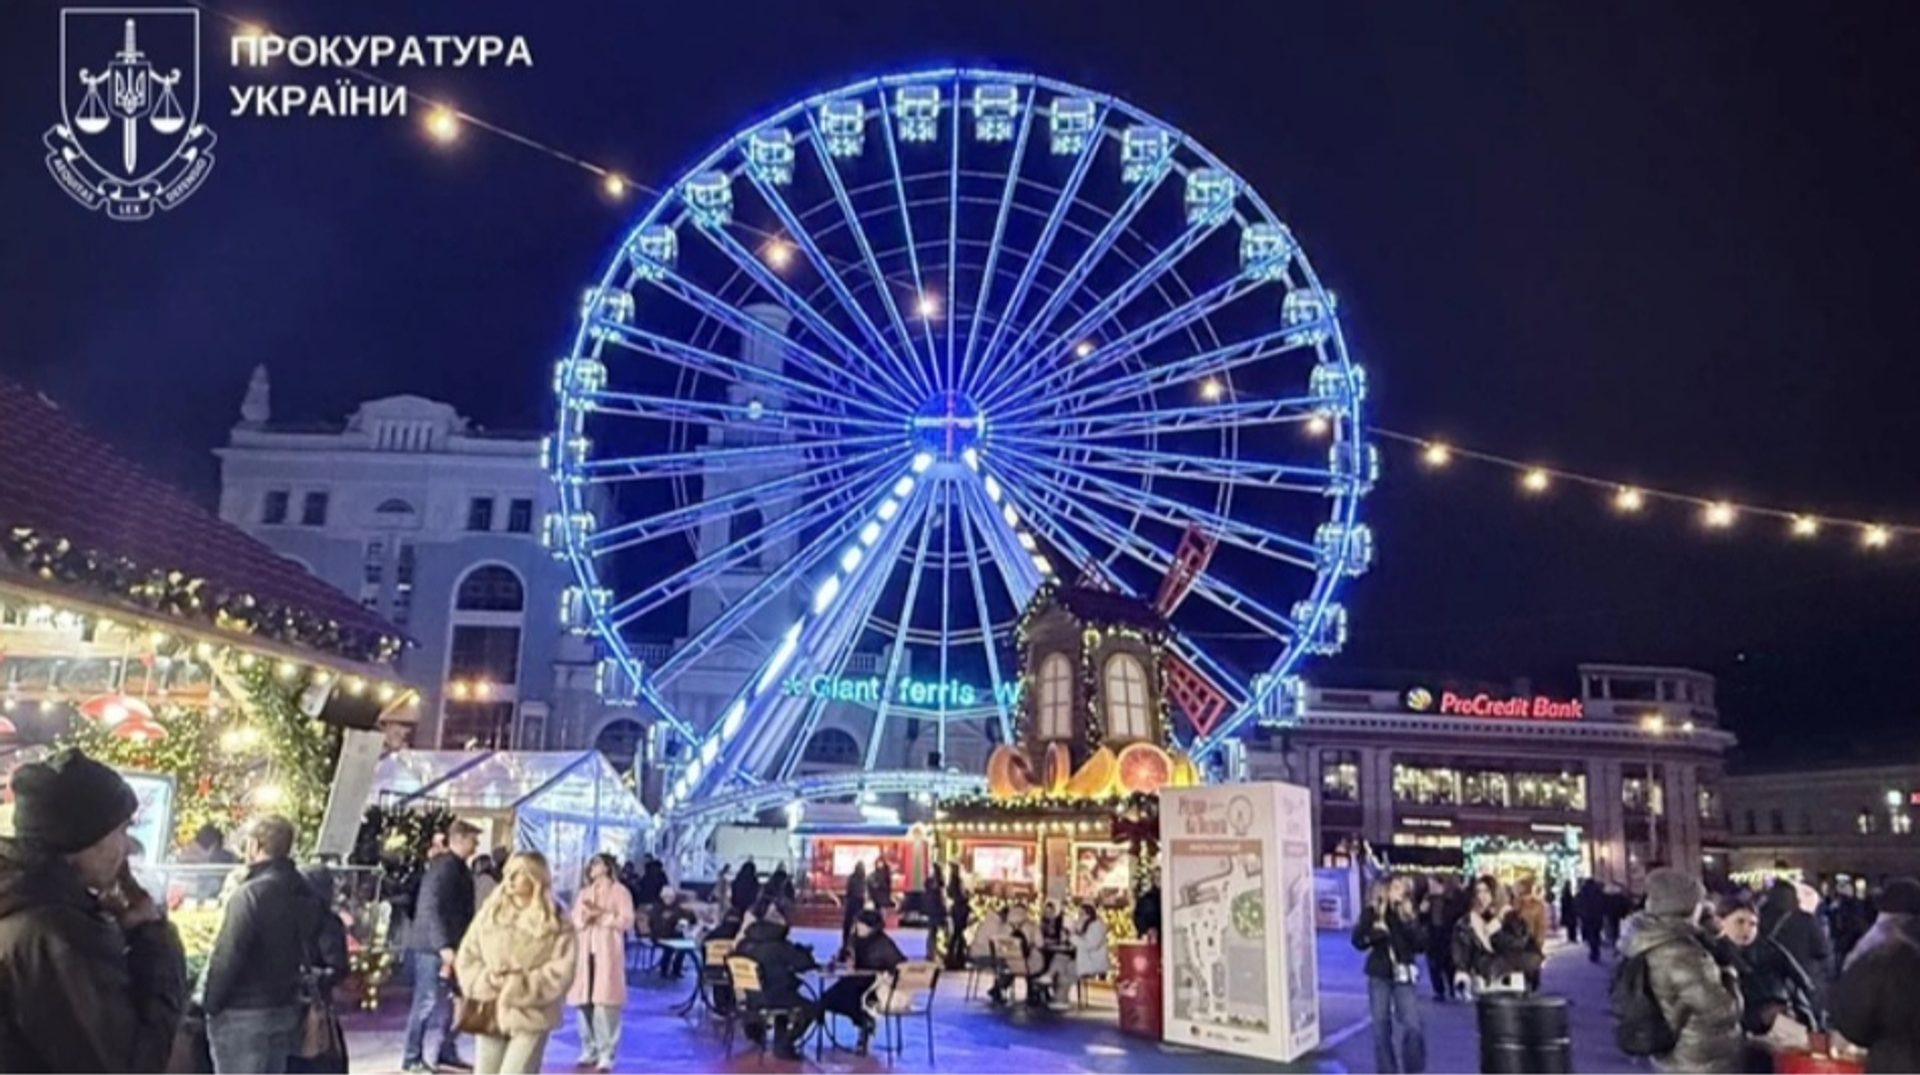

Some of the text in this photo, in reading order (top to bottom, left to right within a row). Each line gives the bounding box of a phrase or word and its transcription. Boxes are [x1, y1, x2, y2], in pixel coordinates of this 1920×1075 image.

[810, 674, 879, 701] Giant
[900, 677, 976, 705] ferris
[1440, 692, 1583, 718] ProCredit Bank
